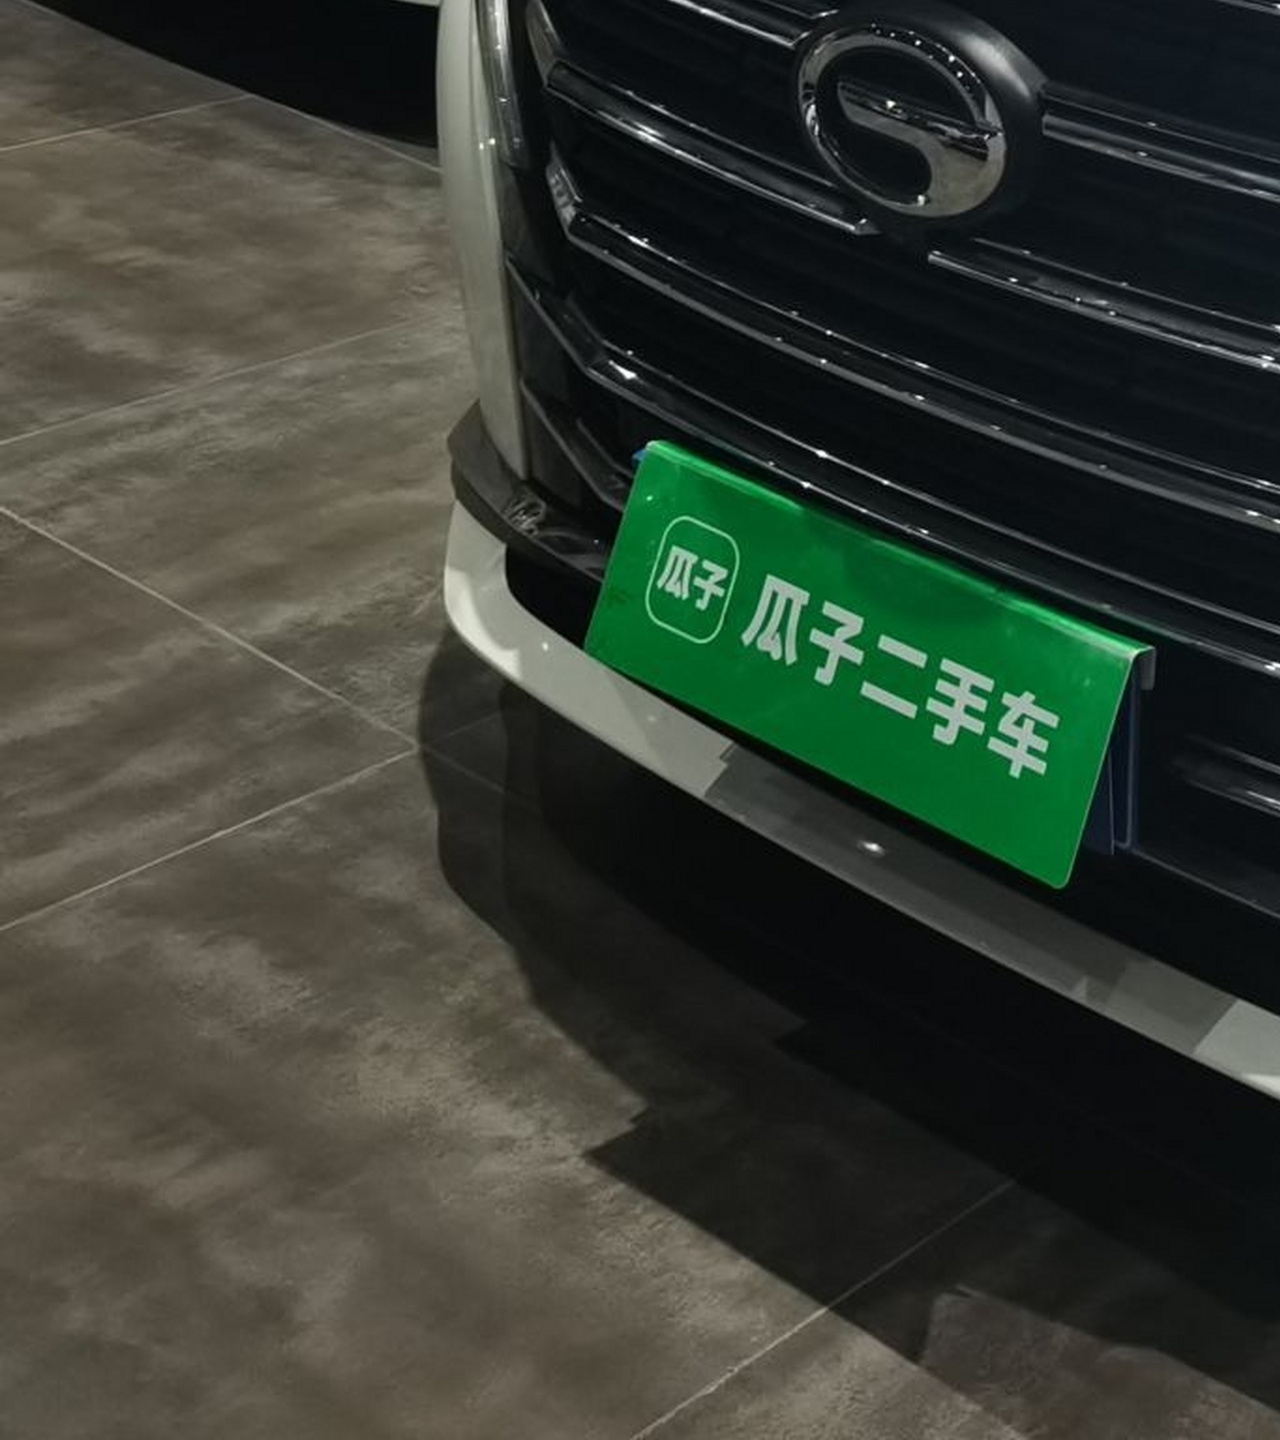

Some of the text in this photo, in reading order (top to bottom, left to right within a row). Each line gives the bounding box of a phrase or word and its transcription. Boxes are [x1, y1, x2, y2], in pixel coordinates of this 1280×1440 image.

[656, 545, 729, 611] 瓜子
[741, 573, 1060, 779] 瓜子二手车
